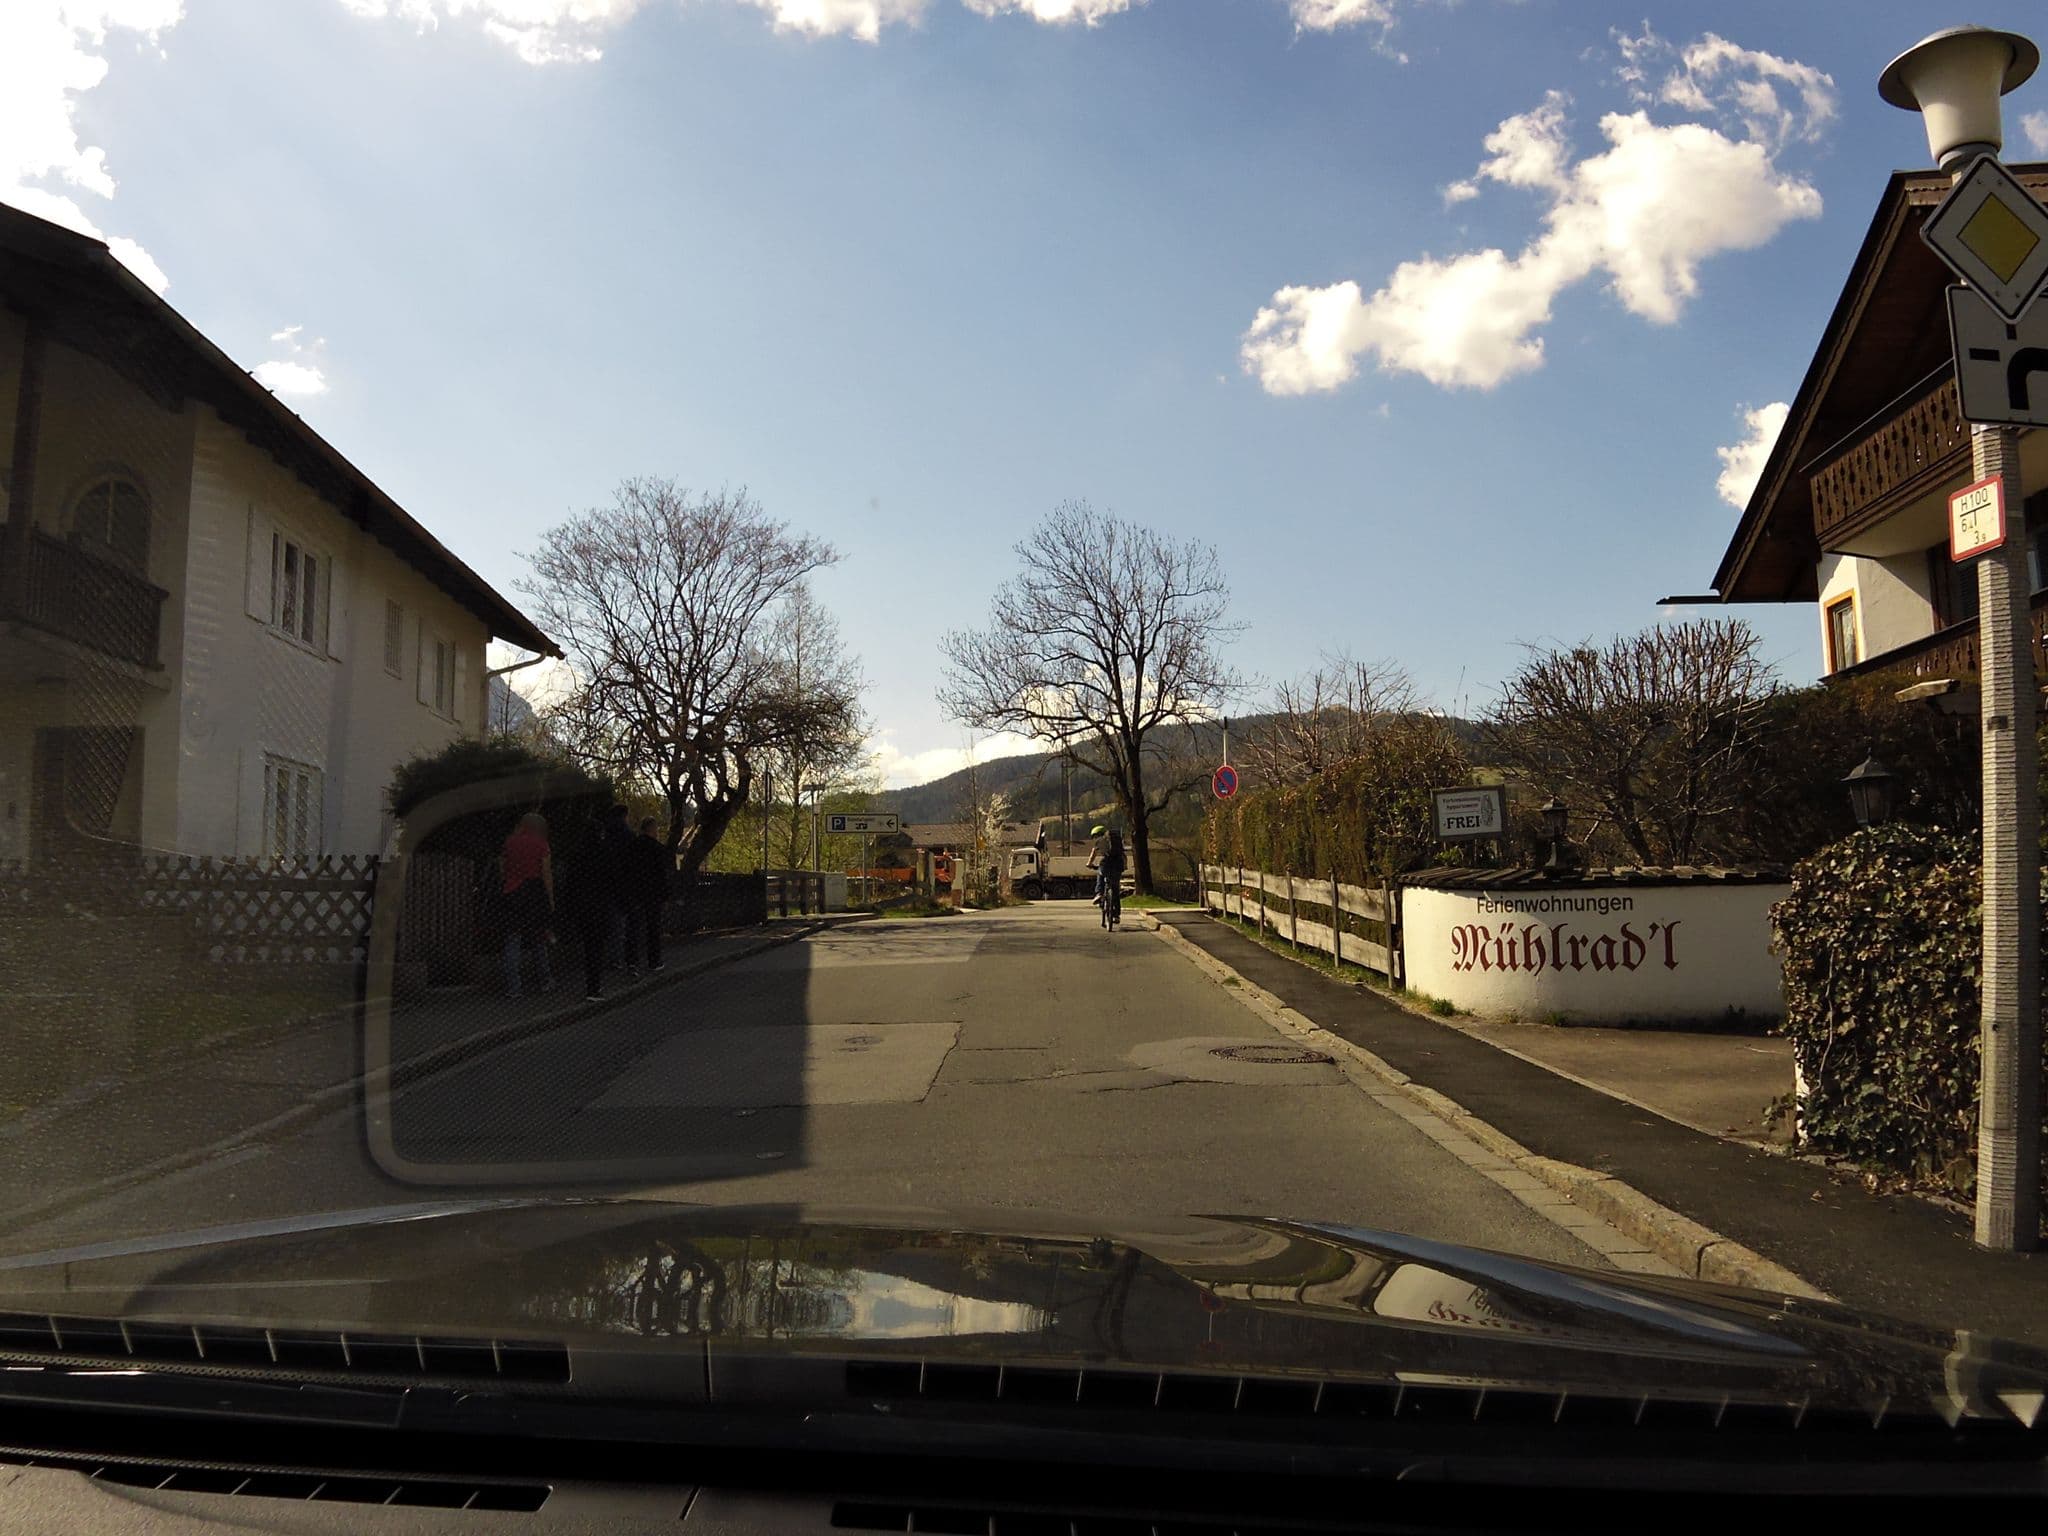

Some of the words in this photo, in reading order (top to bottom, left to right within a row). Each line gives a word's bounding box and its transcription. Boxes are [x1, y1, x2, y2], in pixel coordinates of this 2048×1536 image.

[1446, 815, 1481, 829] FREI
[1477, 896, 1633, 914] Ferienwohnungen
[1451, 921, 1681, 976] Mühlrad'l
